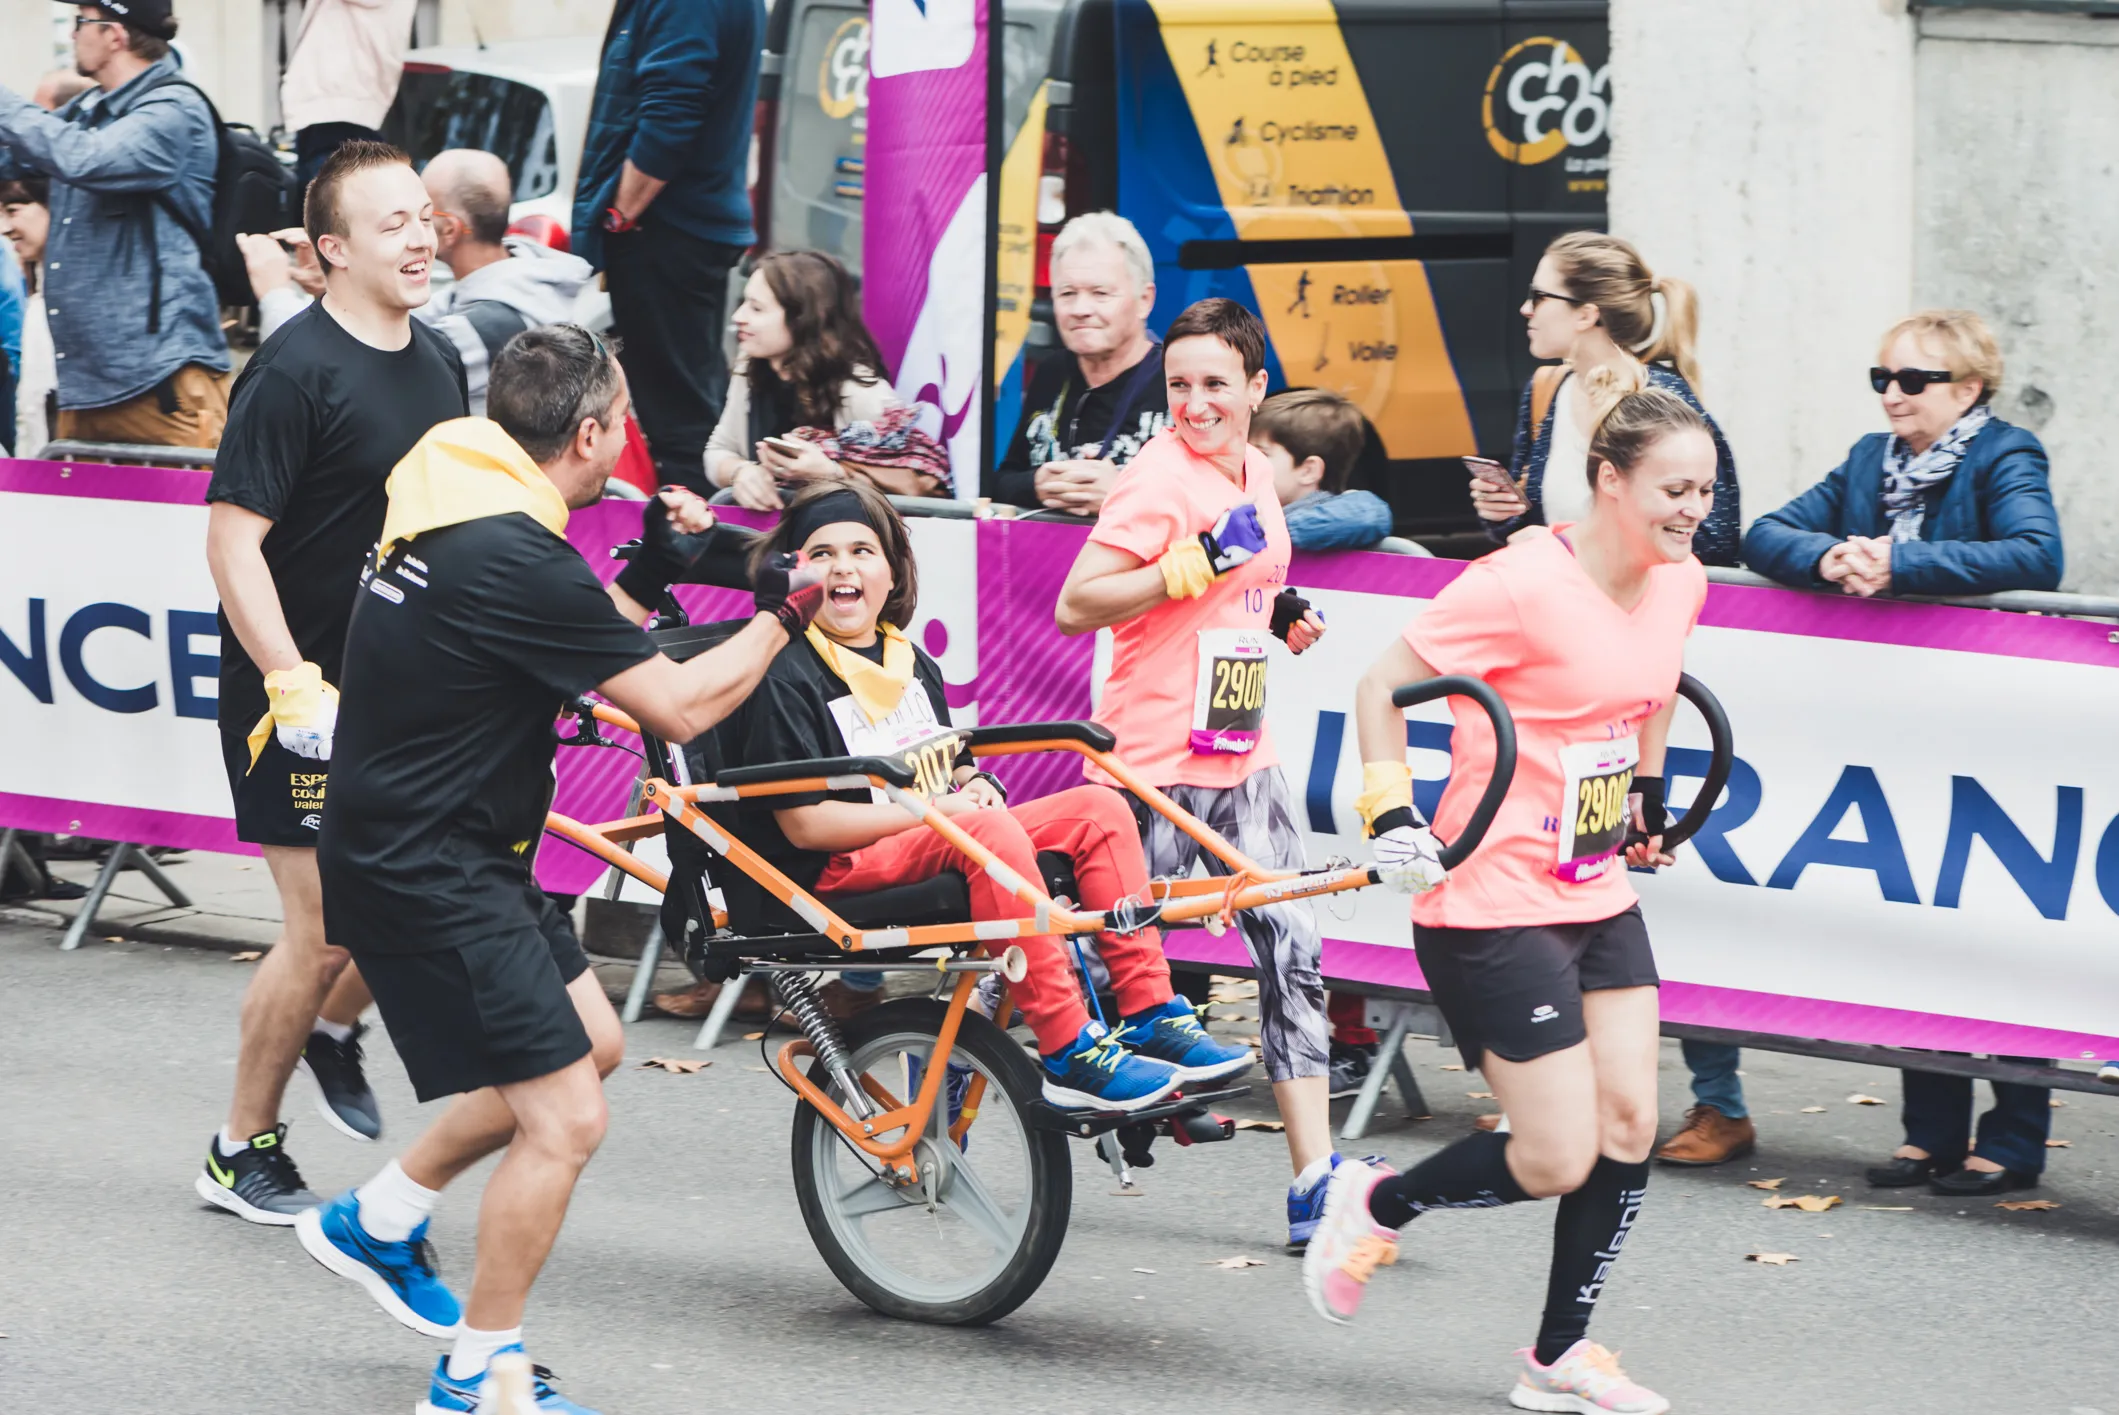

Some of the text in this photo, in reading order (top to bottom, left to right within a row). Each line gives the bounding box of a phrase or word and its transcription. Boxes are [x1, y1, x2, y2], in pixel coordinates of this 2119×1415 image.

[1229, 41, 1306, 62] Course
[1289, 67, 1339, 89] pied
[1259, 121, 1358, 145] Cyclisme
[1288, 184, 1374, 205] Triathlon
[1332, 284, 1392, 305] Roller
[1348, 340, 1398, 361] Voile
[1244, 588, 1263, 613] 10
